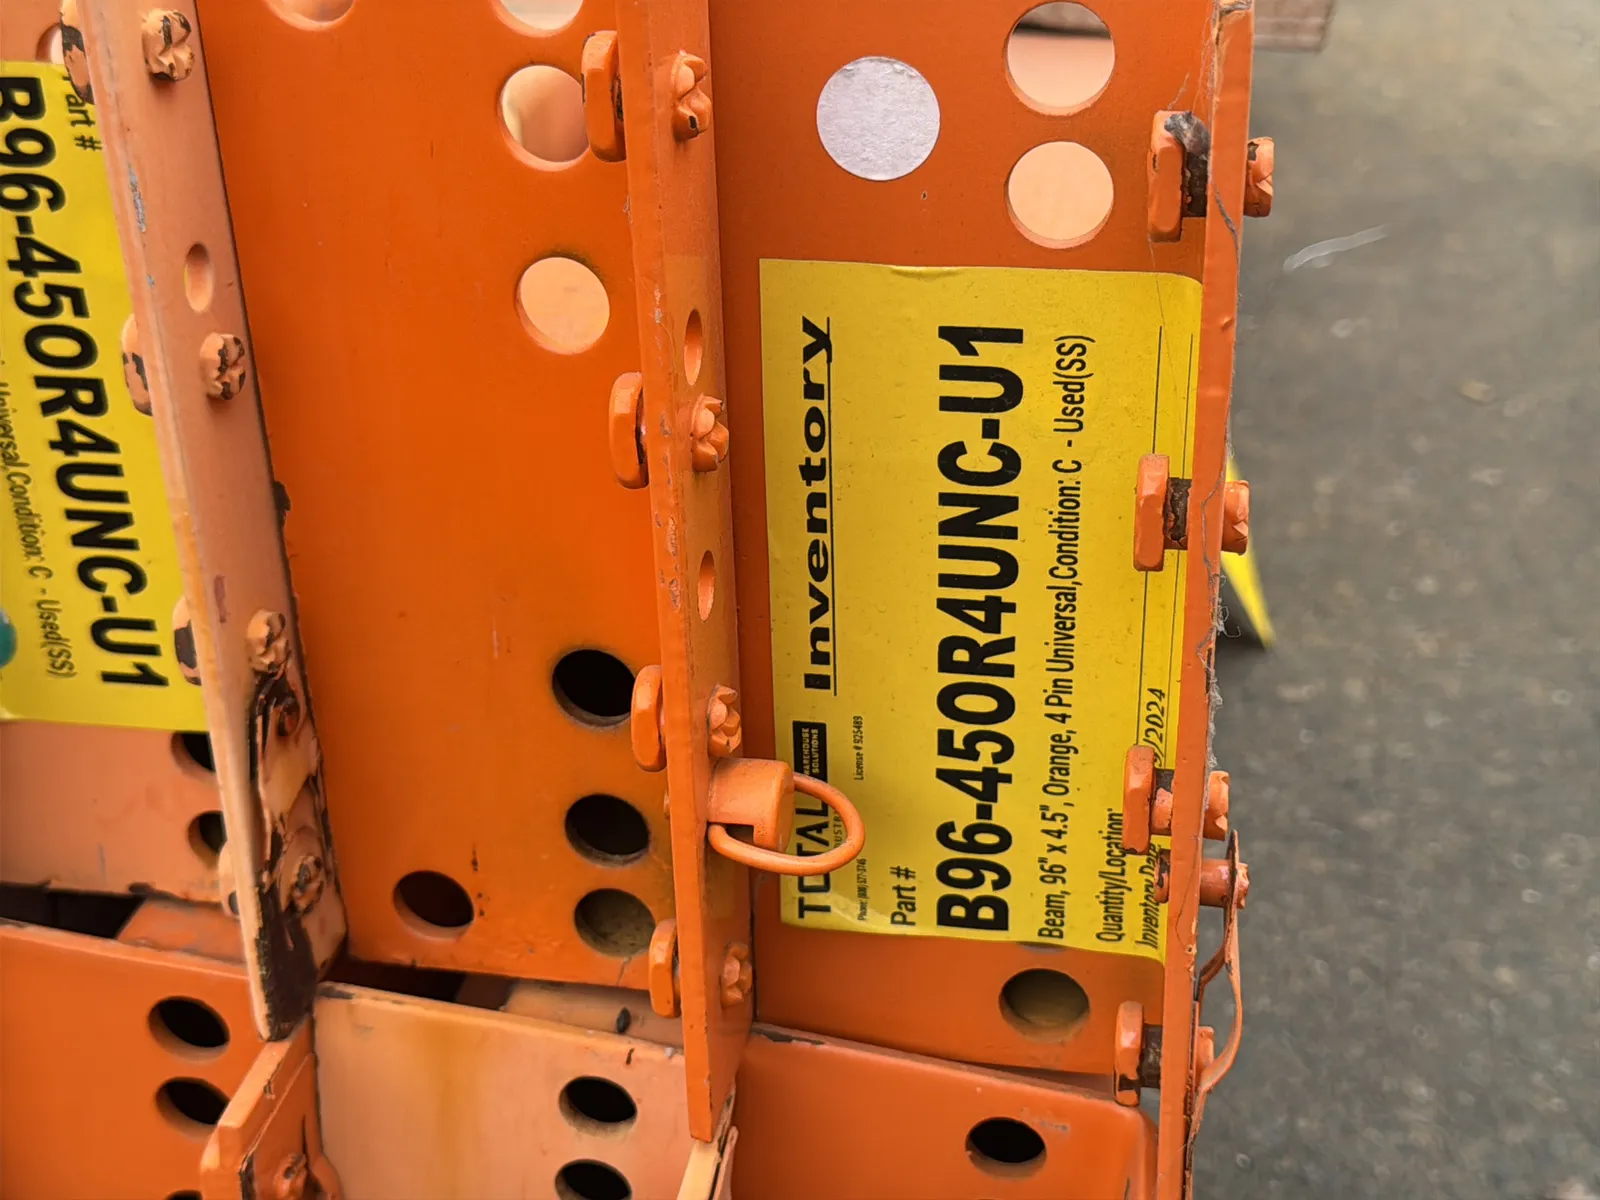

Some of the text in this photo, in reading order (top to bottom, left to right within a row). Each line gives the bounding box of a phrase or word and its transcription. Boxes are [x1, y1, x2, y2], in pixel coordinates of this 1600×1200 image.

[73, 134, 103, 151] #
[1052, 335, 1096, 432] Used(SS)
[1052, 459, 1082, 473] C
[798, 315, 833, 691] Inventory
[28, 565, 54, 580] C
[36, 599, 78, 680] Used(SS)
[1043, 678, 1073, 708] Pin
[1044, 712, 1072, 724] 4
[802, 727, 810, 776] WAREHOUSE
[810, 728, 819, 774] SOLUTIONS
[853, 752, 864, 781] License
[1041, 729, 1079, 796] Orange,
[1039, 802, 1075, 840] 4.5",
[1046, 843, 1067, 854] x
[1037, 856, 1067, 885] 96"
[890, 866, 916, 926] Part #
[1037, 890, 1071, 939] Beam,
